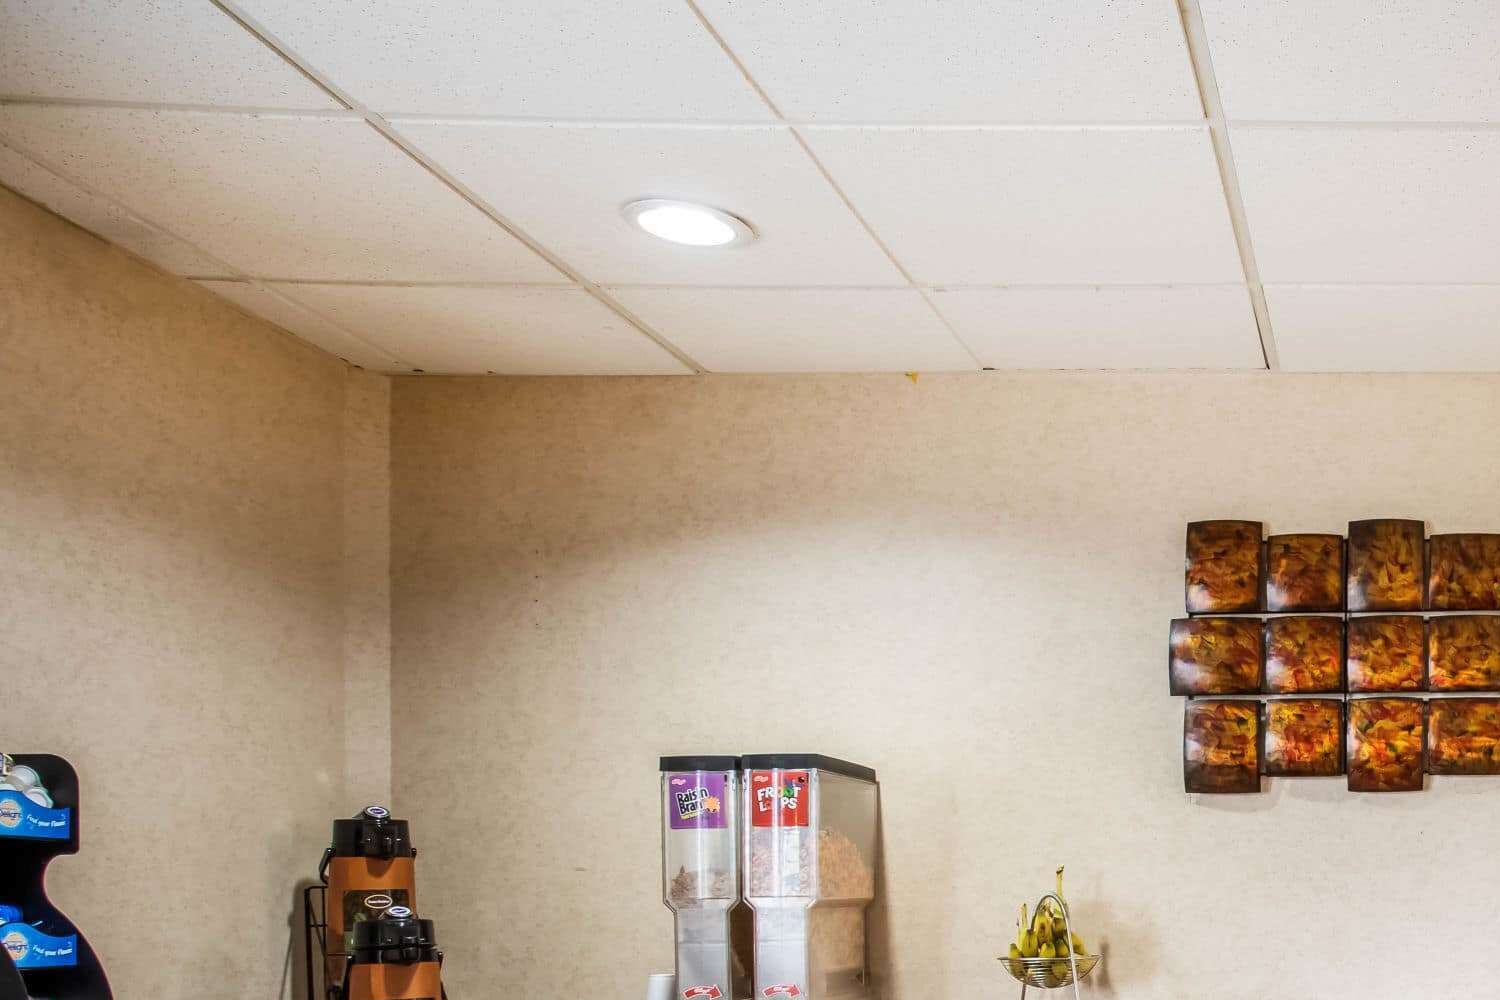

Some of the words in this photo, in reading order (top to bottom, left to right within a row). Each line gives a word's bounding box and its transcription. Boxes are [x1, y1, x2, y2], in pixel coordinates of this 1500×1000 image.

[676, 787, 708, 803] Raisn
[757, 785, 802, 801] FRT
[759, 797, 798, 811] LPS
